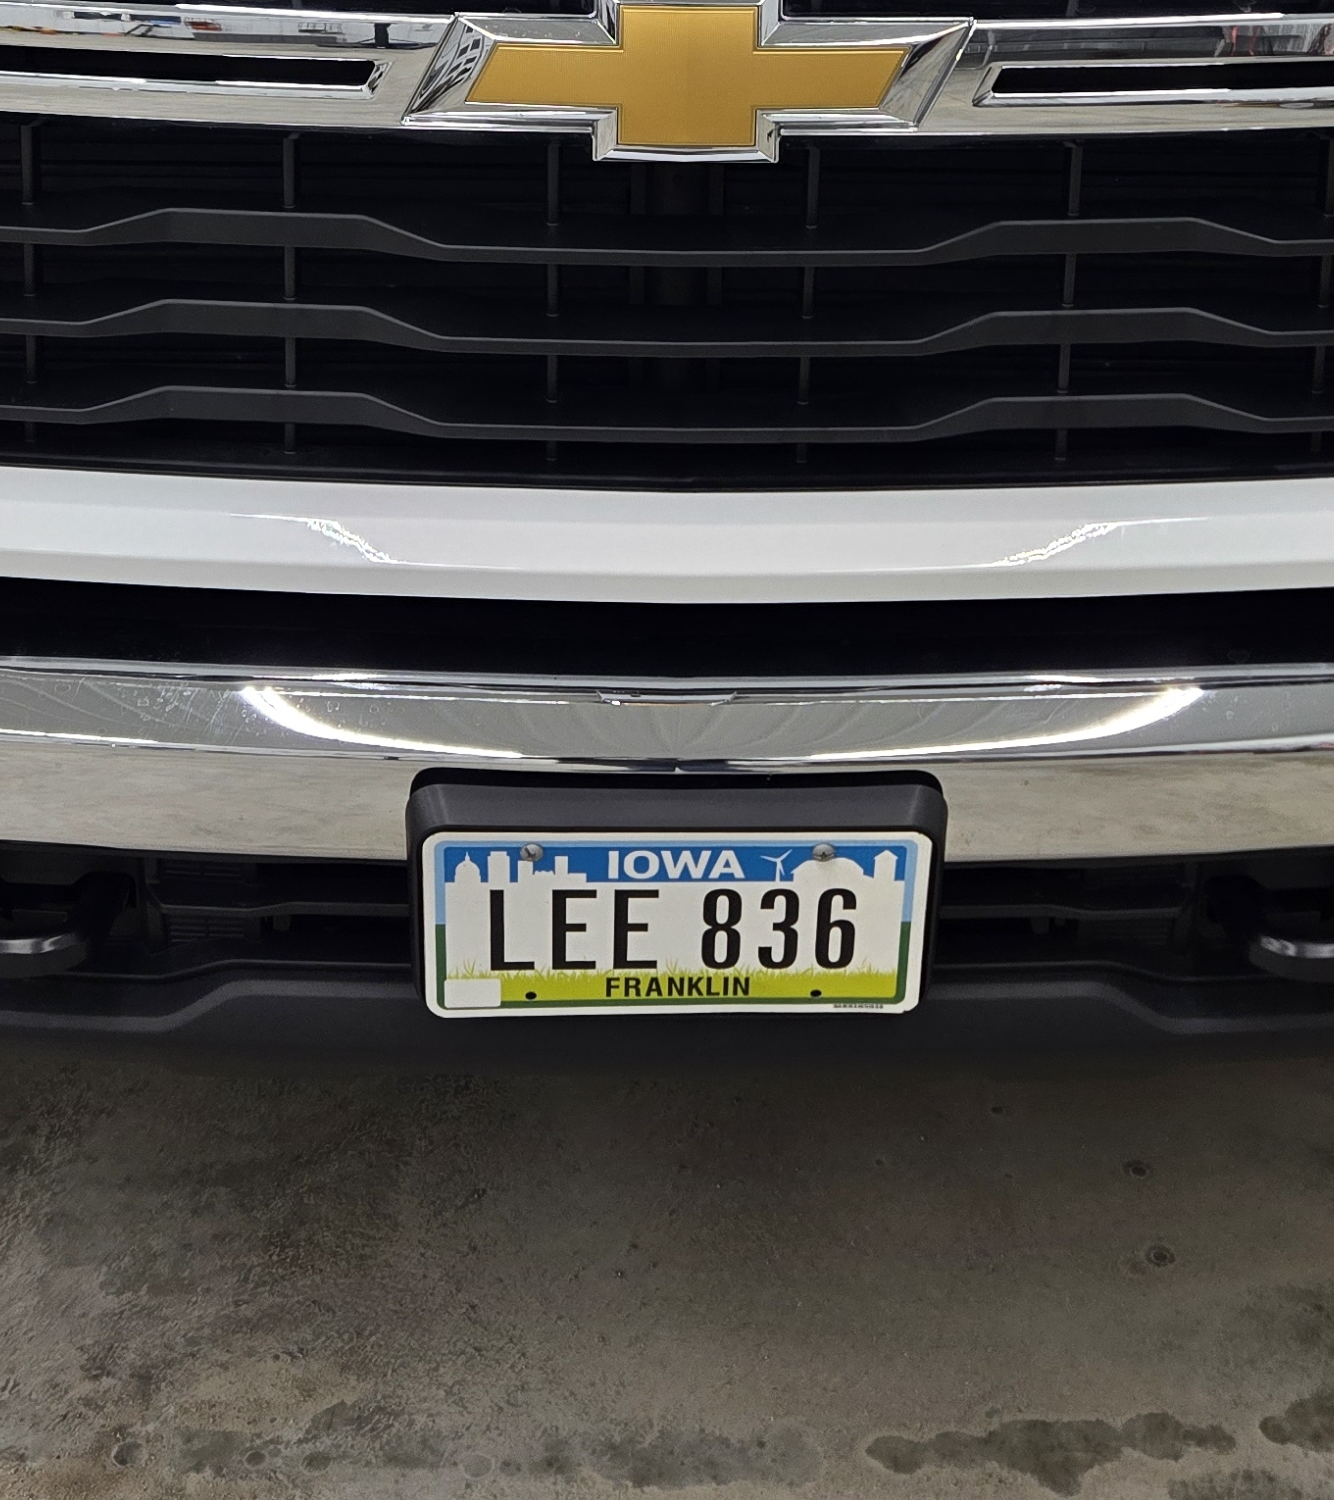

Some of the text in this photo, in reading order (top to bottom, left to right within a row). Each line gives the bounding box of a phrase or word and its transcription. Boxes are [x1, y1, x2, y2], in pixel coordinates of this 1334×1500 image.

[607, 850, 745, 880] IOWA
[489, 888, 857, 972] LEE 836
[605, 977, 751, 998] FRANKLIN
